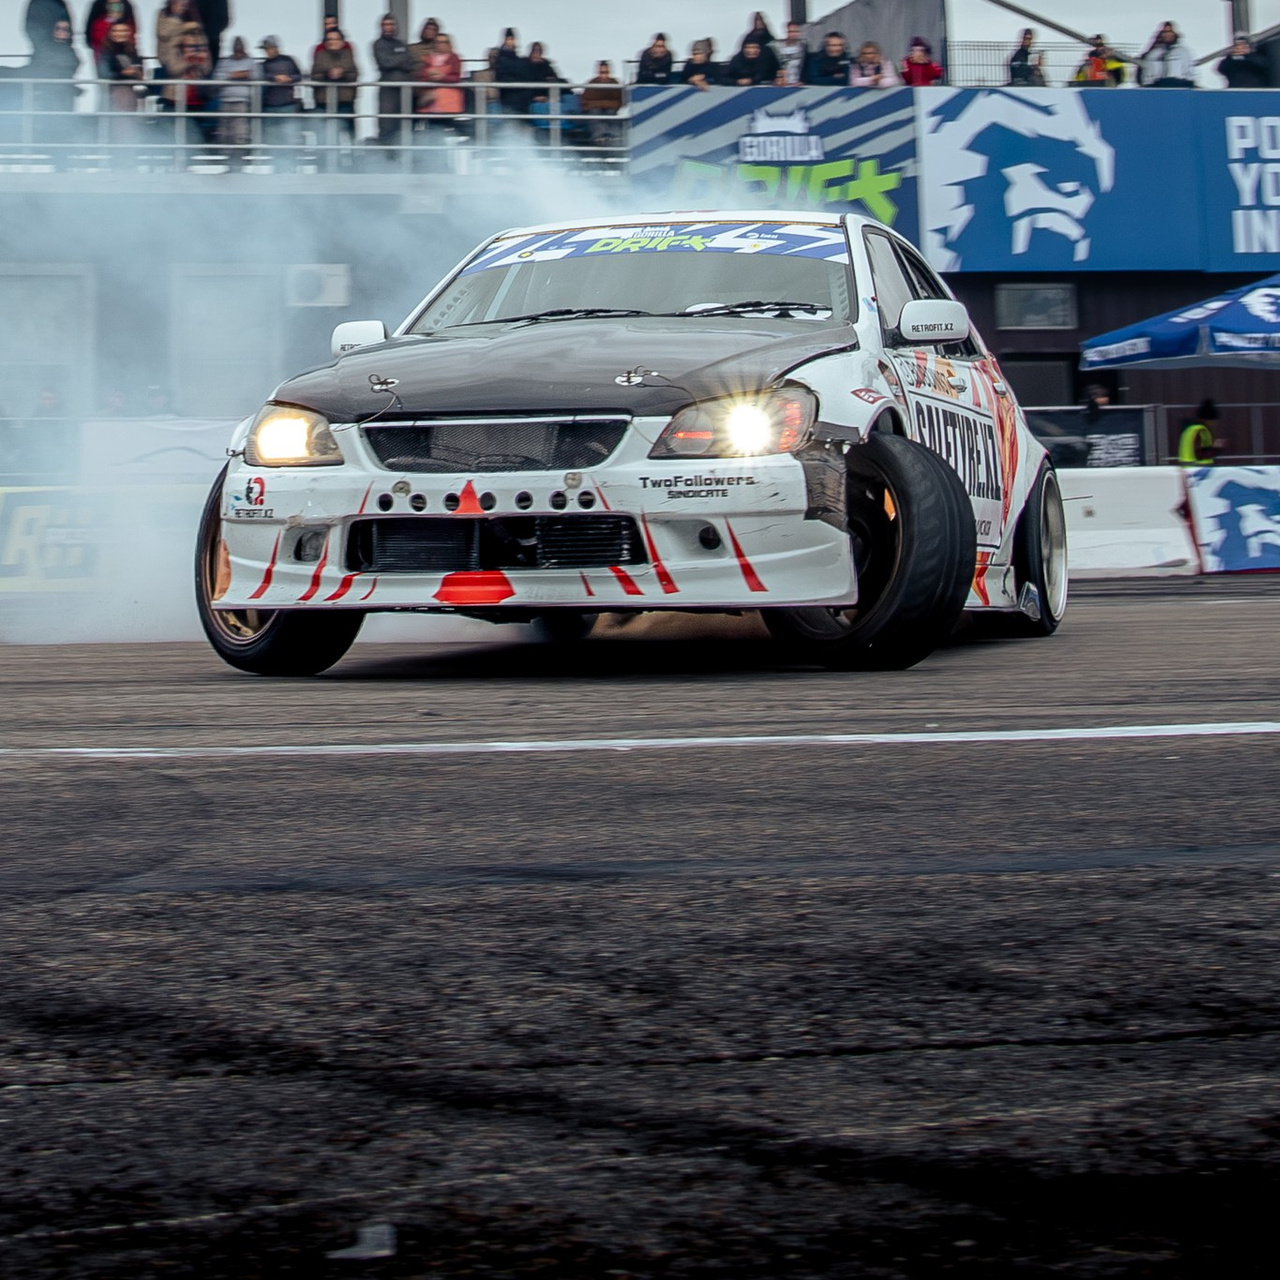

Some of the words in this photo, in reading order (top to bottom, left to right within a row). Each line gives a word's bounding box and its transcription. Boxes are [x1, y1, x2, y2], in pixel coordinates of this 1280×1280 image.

[633, 229, 674, 238] GORILLA
[585, 234, 712, 253] DRIFT
[912, 323, 954, 333] RETROFIT.KZ
[639, 475, 755, 488] TwoFollowers
[667, 489, 729, 499] SINDICATE
